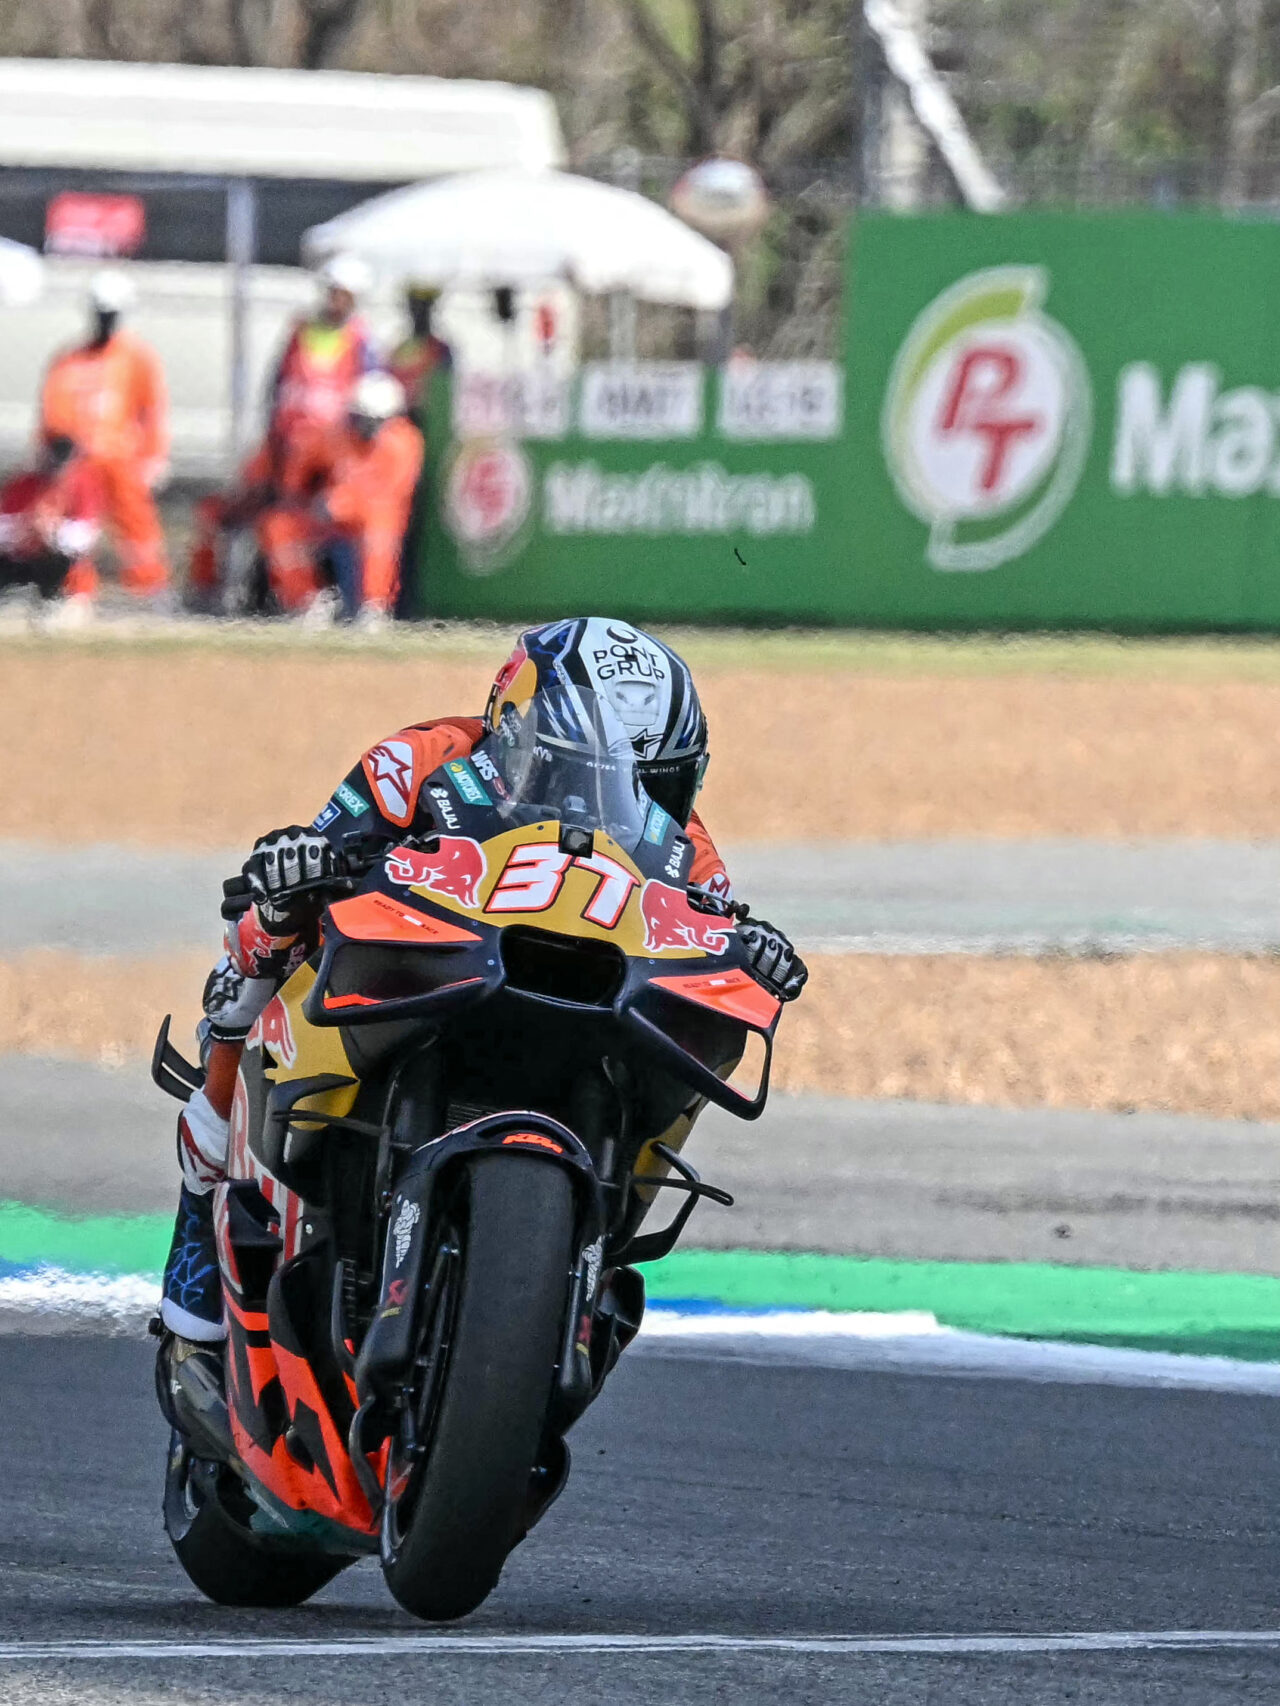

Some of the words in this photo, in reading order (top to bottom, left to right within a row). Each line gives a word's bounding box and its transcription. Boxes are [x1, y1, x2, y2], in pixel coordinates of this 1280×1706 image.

[593, 644, 658, 667] PONT
[597, 660, 665, 680] GRUP
[471, 750, 499, 781] WRS
[437, 799, 461, 830] BAJAJ
